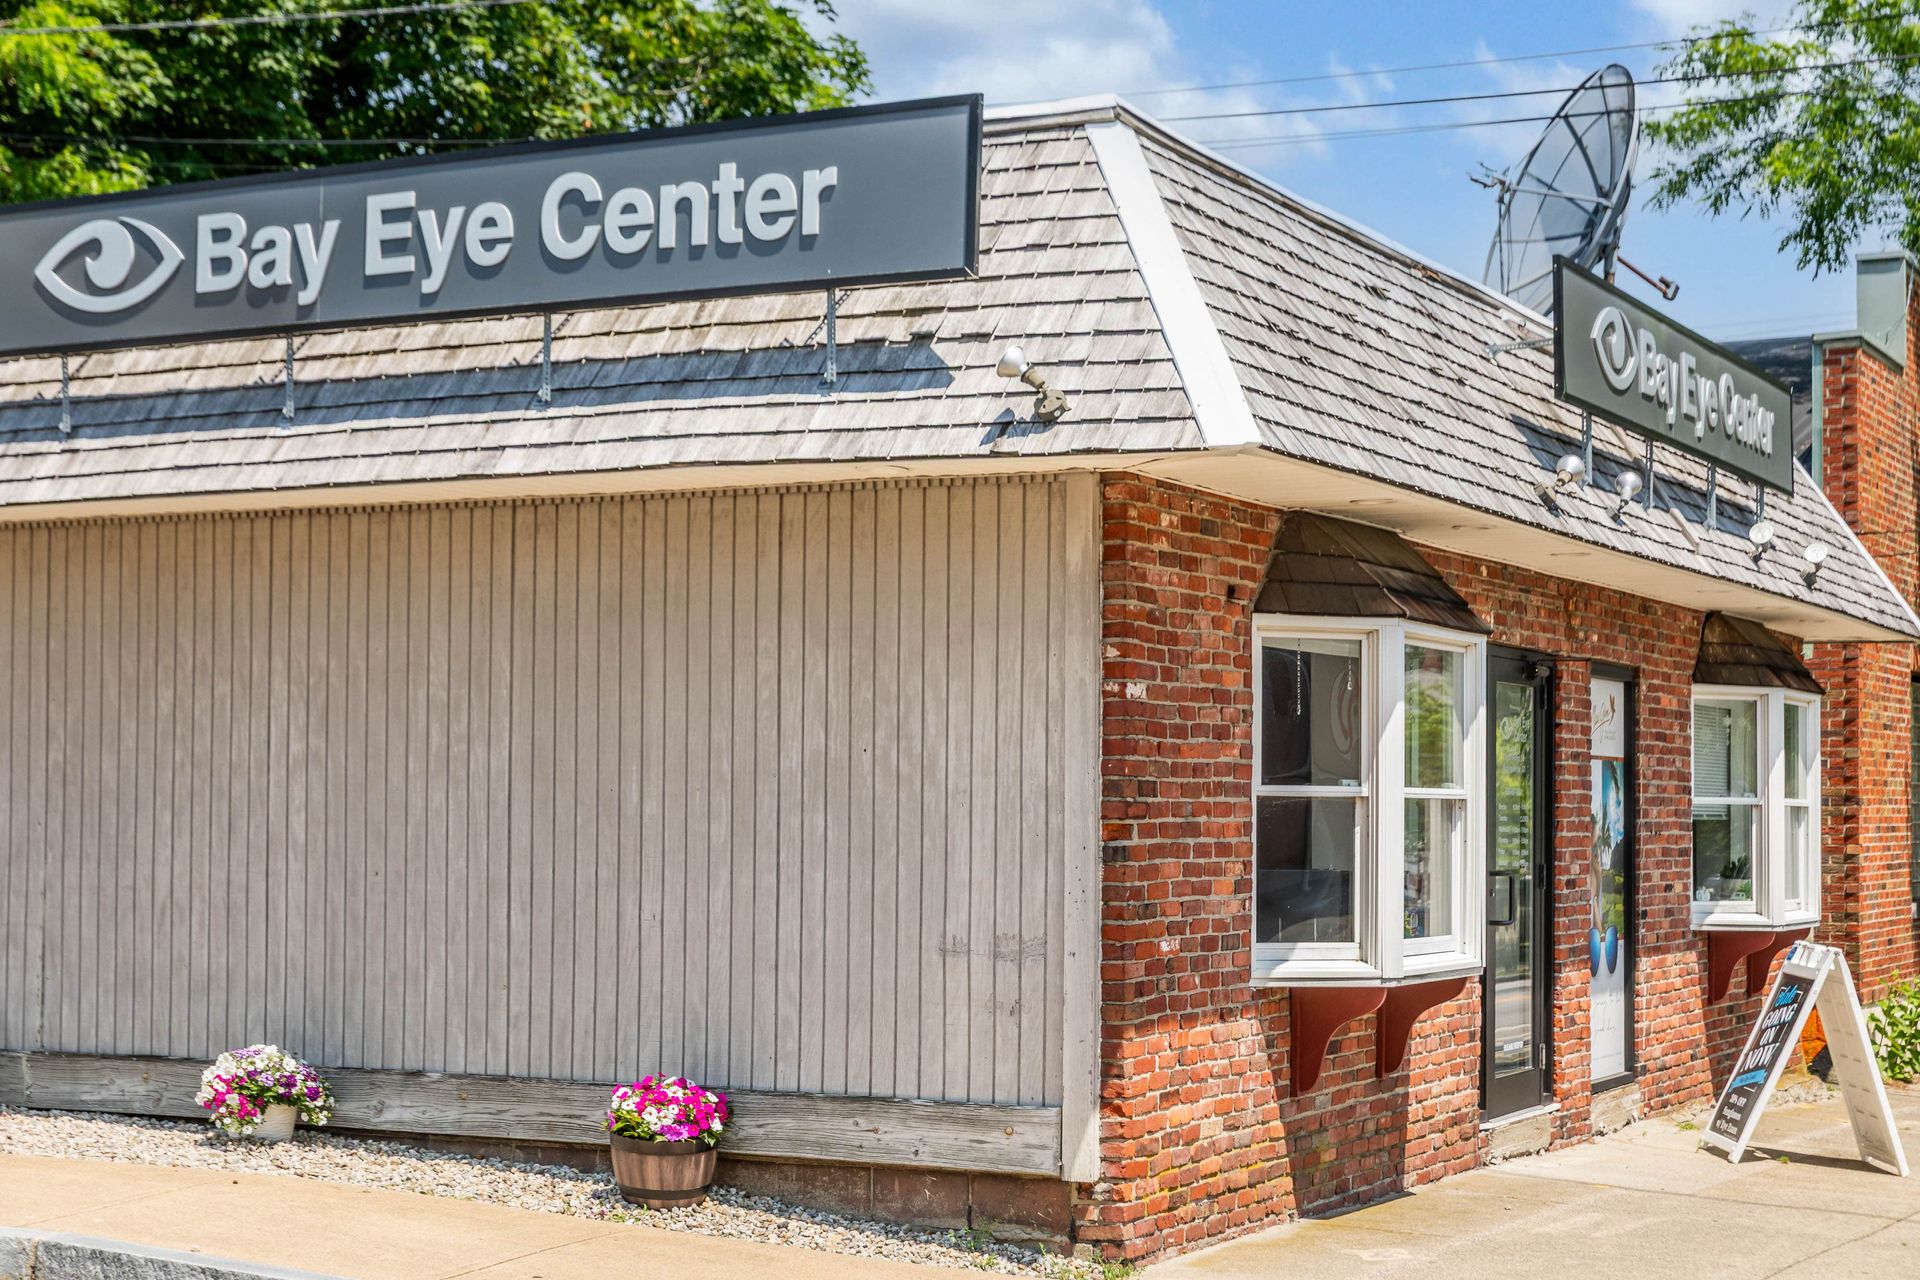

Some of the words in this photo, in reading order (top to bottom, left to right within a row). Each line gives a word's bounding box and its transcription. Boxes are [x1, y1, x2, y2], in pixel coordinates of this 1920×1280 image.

[194, 212, 341, 306] Bay
[364, 189, 516, 294] Eye
[540, 161, 839, 261] Center
[1637, 327, 1679, 425] Bay
[1679, 351, 1719, 438] Eye
[1718, 372, 1775, 454] Center
[1761, 1003, 1799, 1029] GOING
[1759, 1025, 1780, 1047] ON
[1740, 1042, 1780, 1072] NOW
